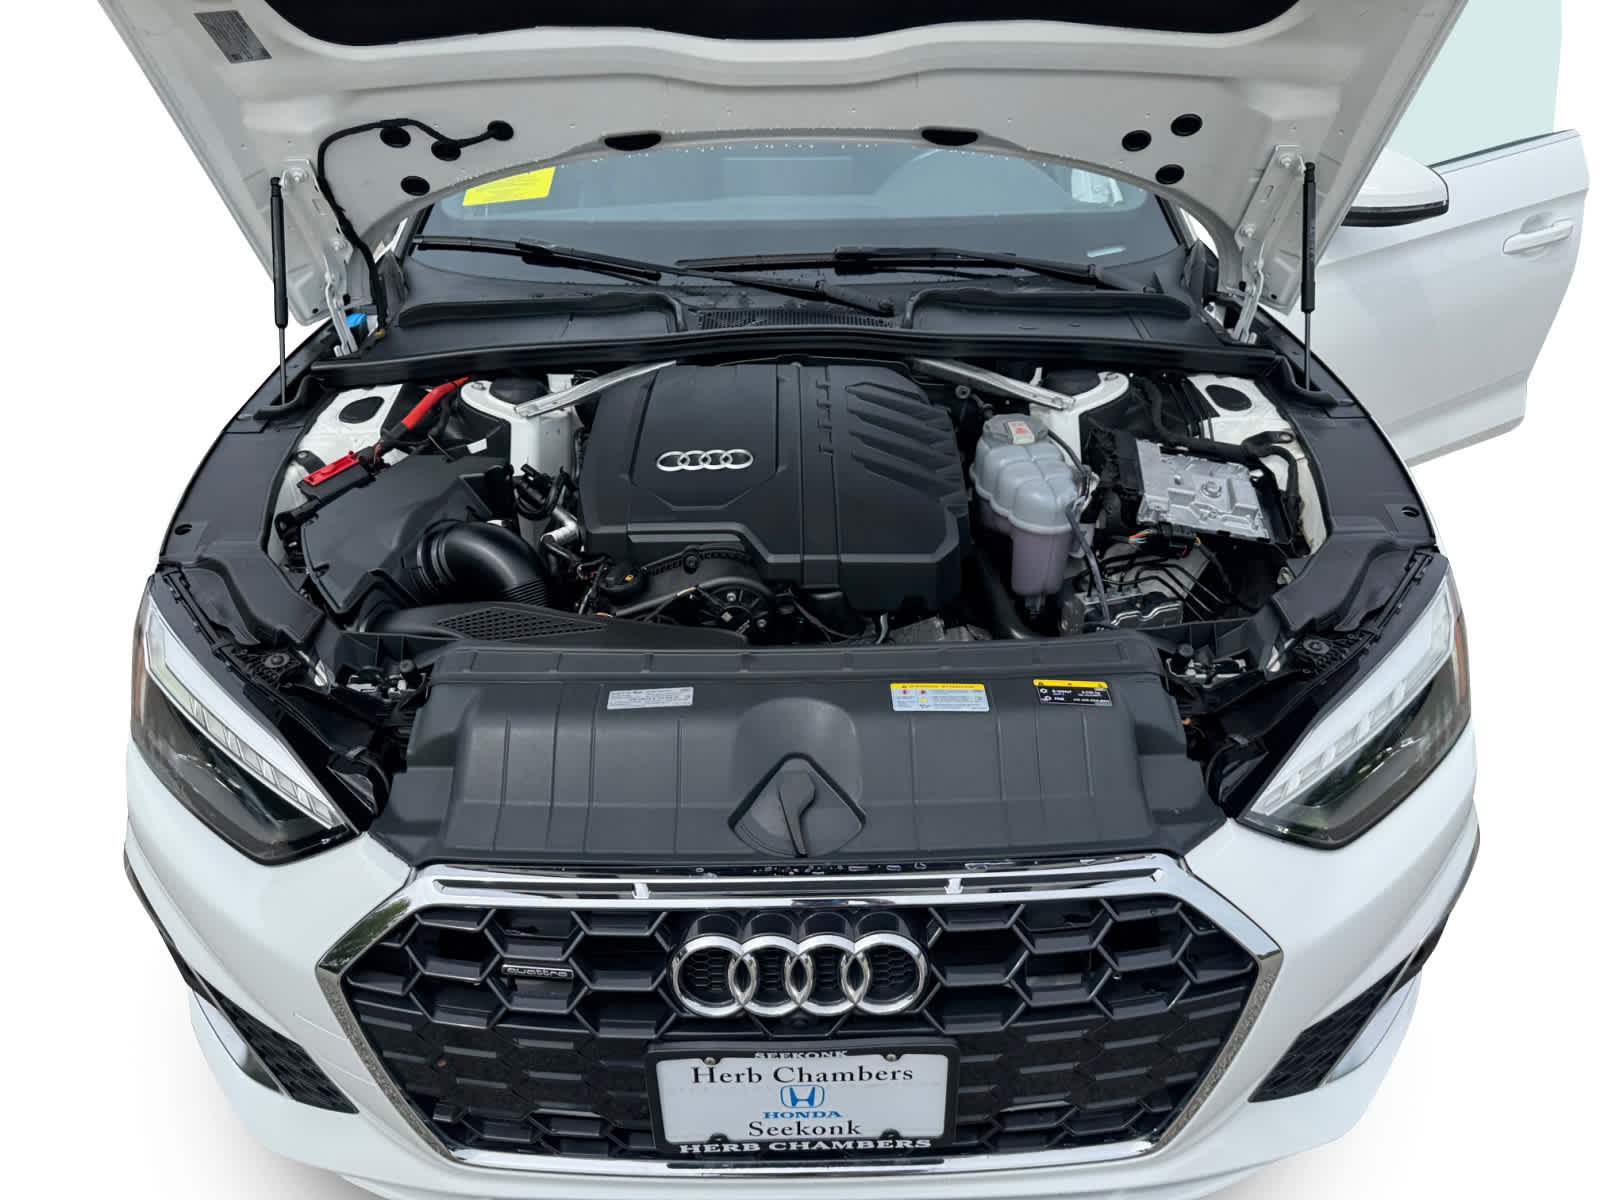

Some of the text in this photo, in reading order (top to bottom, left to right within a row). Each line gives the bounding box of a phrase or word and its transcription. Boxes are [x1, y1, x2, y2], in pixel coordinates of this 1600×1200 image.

[507, 966, 568, 977] quattro
[692, 1065, 914, 1084] Herb Chambers
[763, 1110, 842, 1119] HONDA
[748, 1120, 862, 1137] Seekonk
[679, 1139, 932, 1154] HERB CHAMBERS
